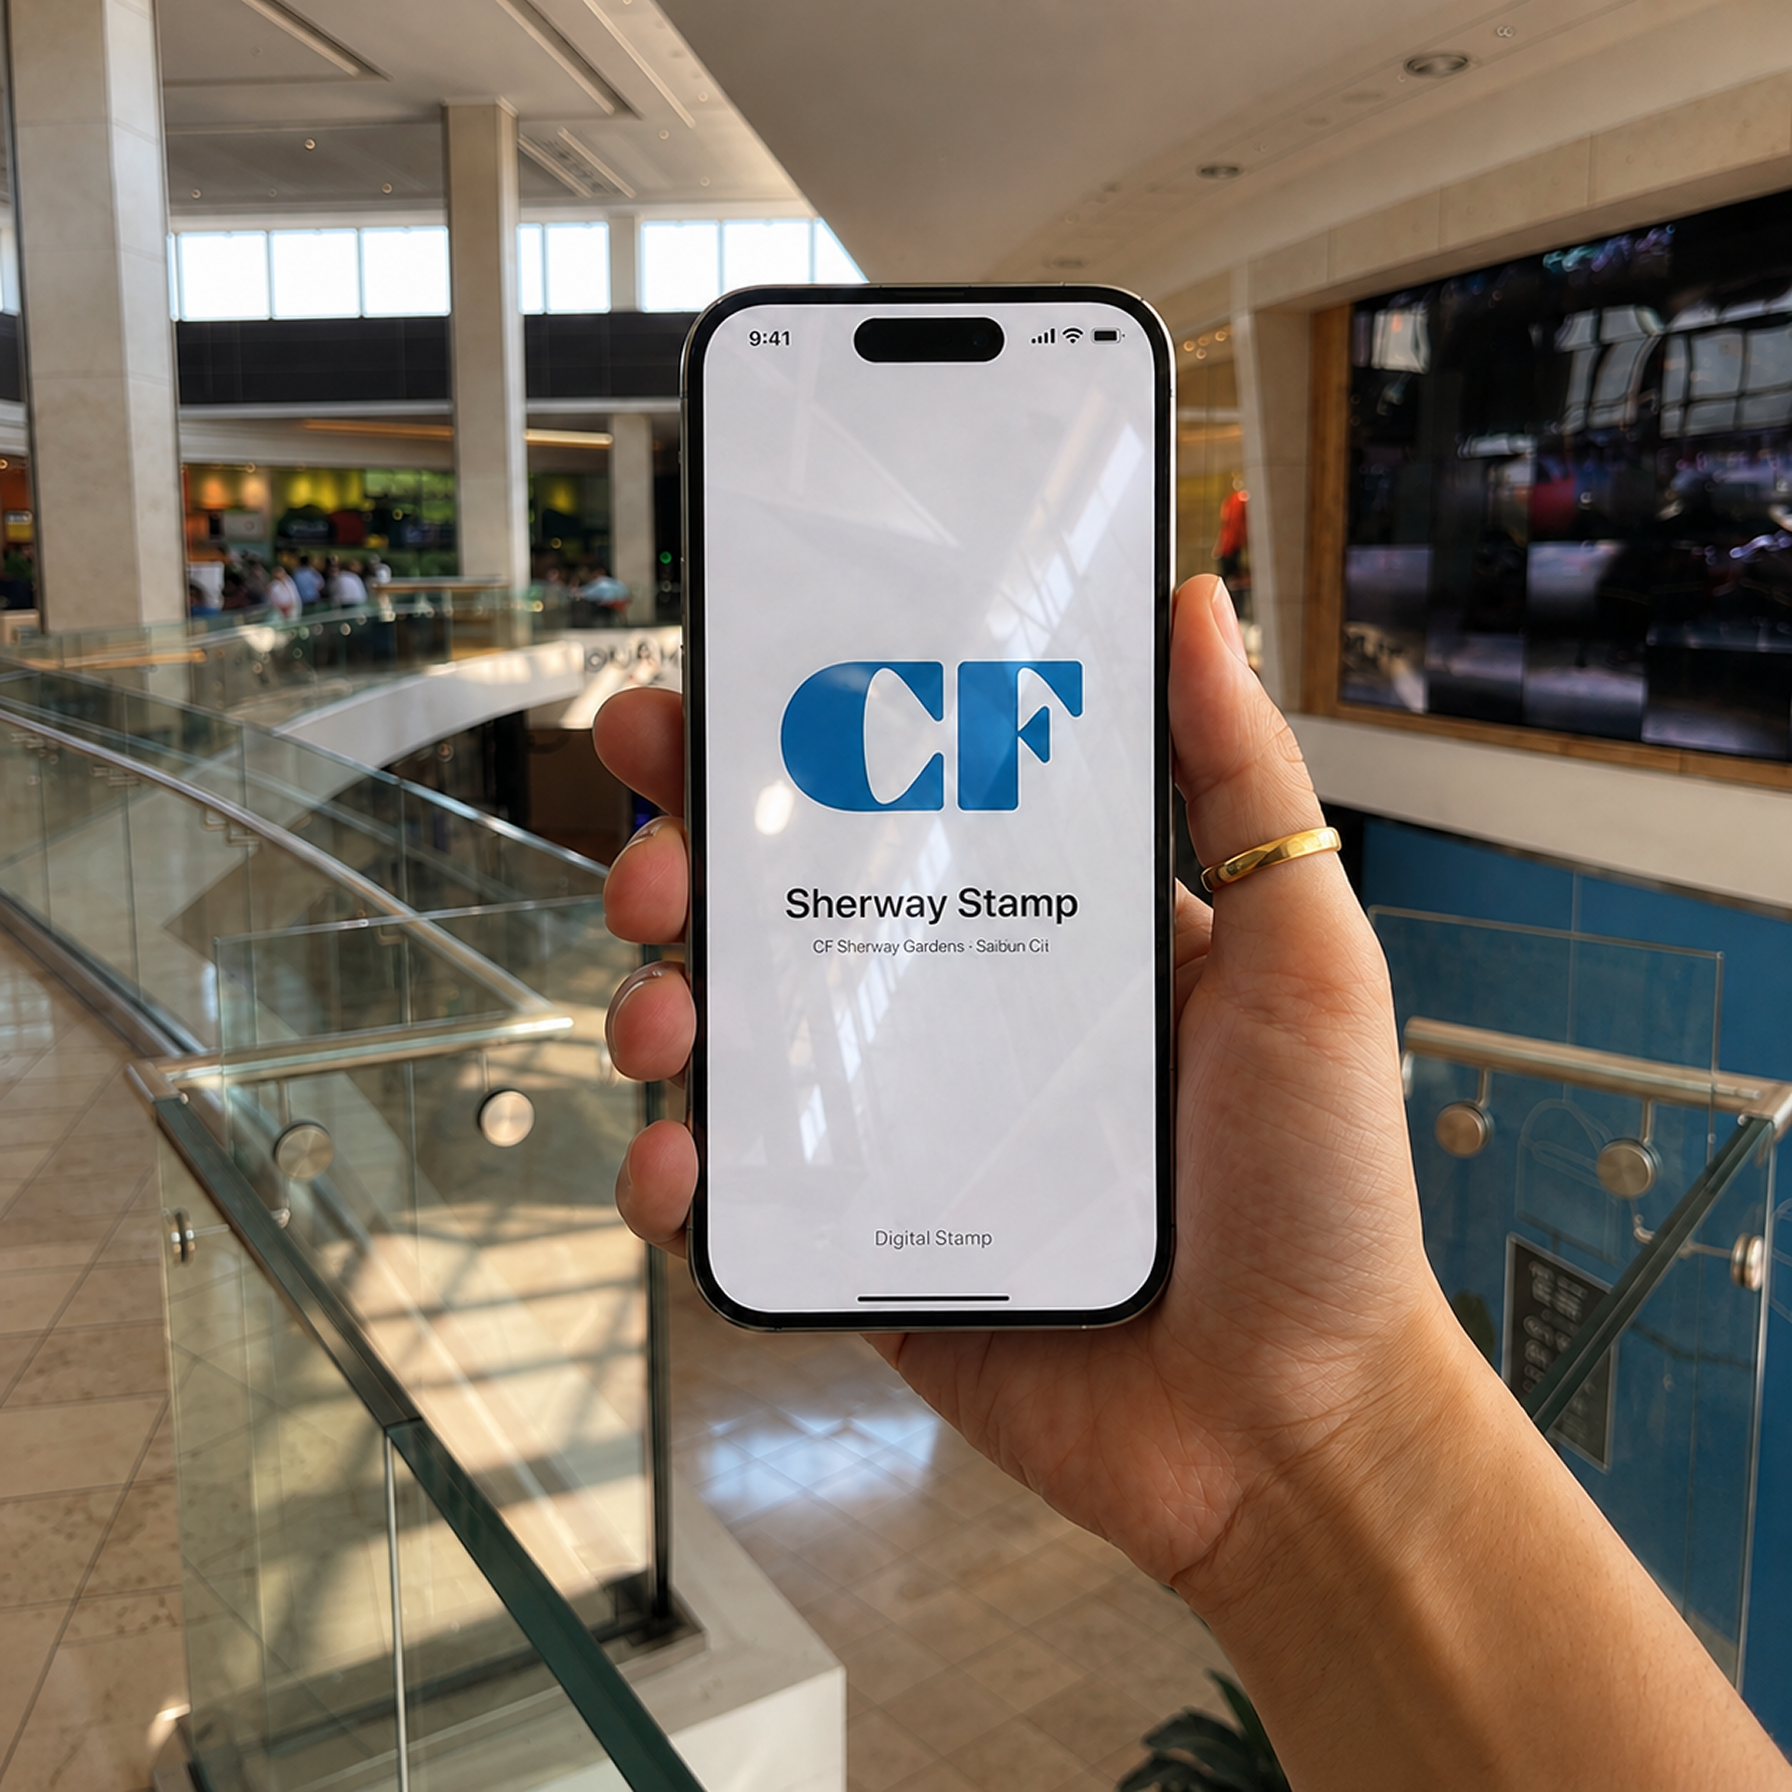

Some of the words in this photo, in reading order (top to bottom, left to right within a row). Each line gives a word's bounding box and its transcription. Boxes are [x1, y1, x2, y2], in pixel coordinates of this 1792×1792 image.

[749, 330, 790, 347] 9:41
[780, 661, 1083, 812] CF
[785, 887, 948, 925] Sherway
[958, 887, 1078, 925] Stamp
[813, 939, 833, 953] CF
[837, 939, 900, 956] Sherway
[903, 939, 965, 953] Gardens
[875, 1230, 930, 1250] Digital
[935, 1229, 993, 1248] Stamp
